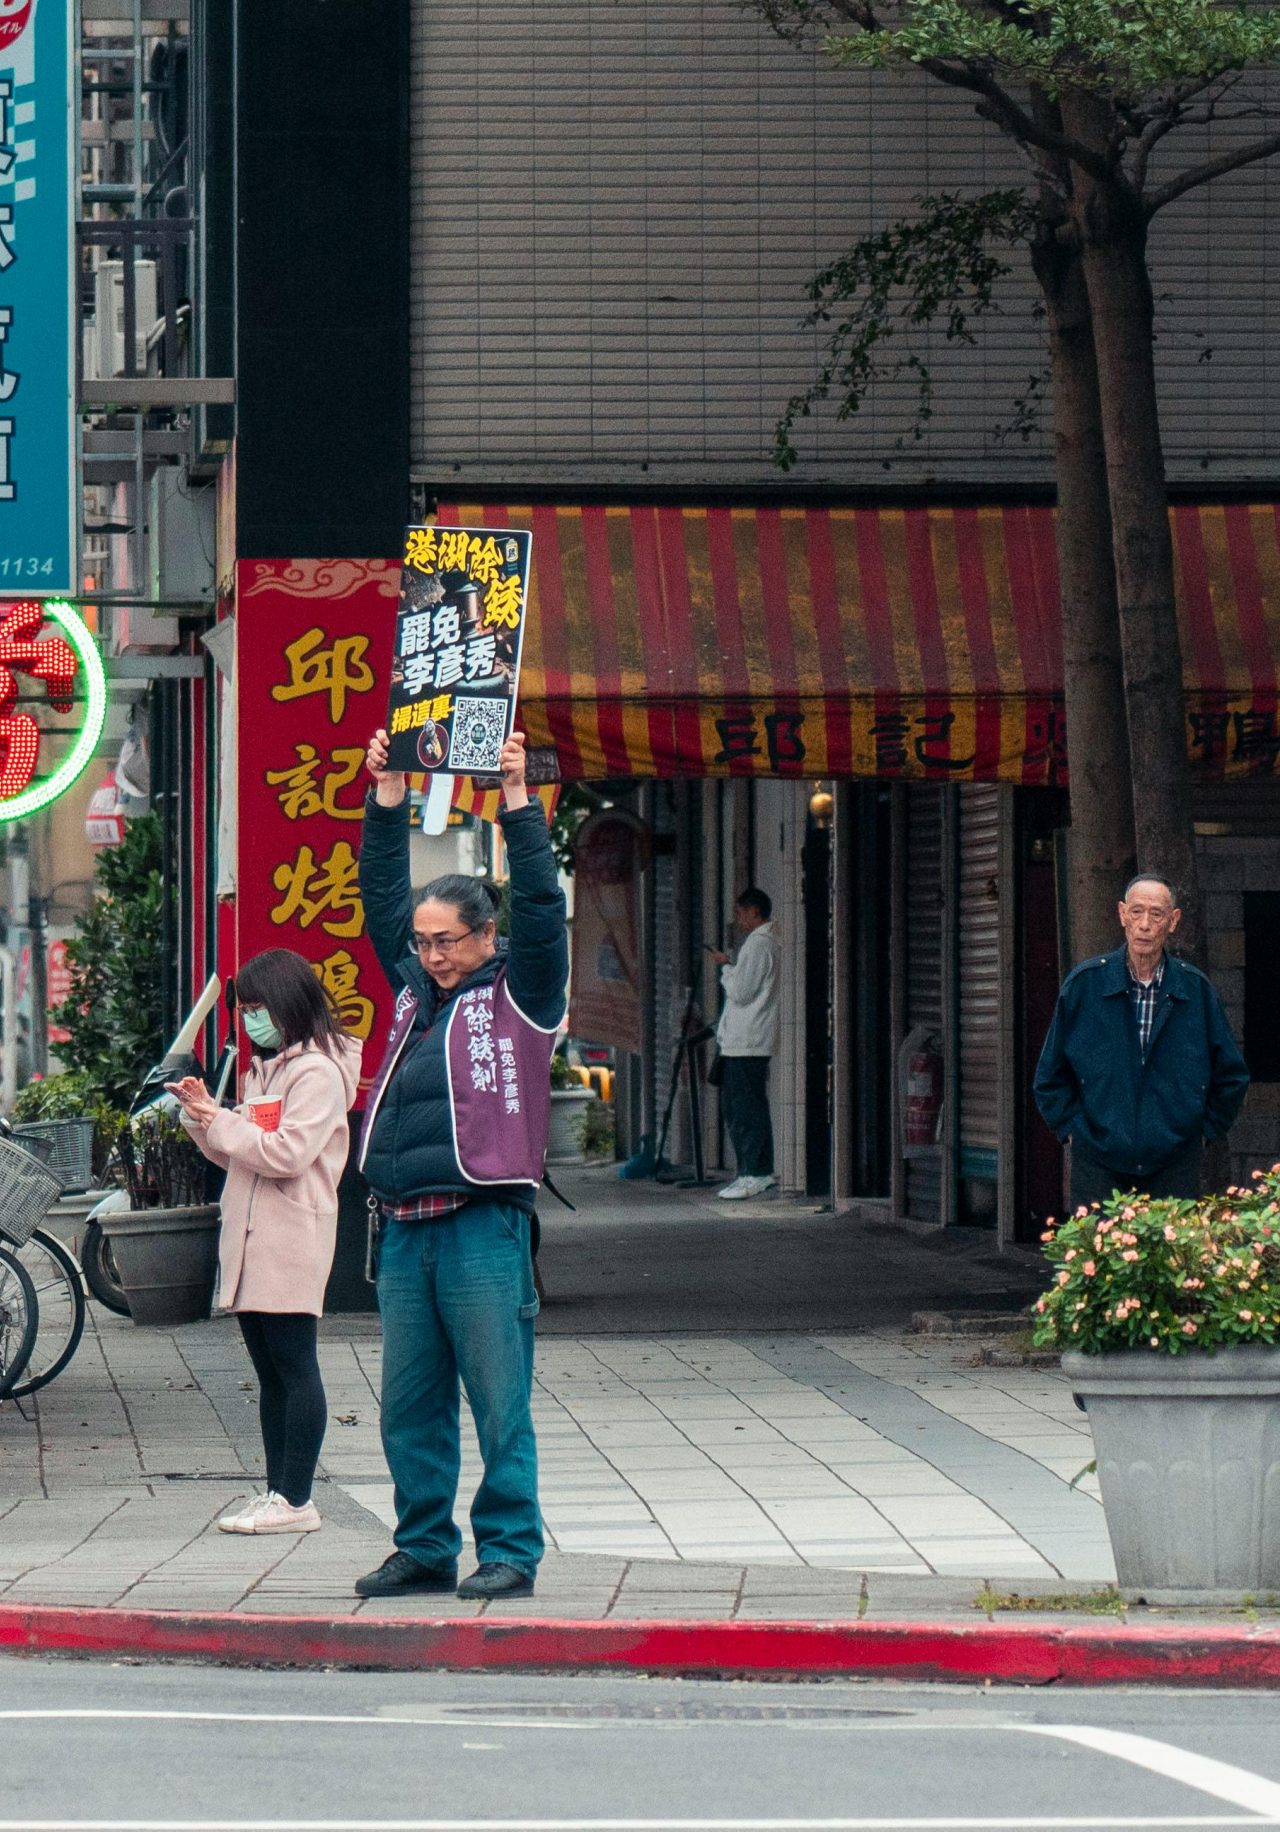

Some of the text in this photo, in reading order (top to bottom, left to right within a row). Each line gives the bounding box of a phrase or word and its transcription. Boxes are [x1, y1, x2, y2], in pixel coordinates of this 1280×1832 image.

[401, 605, 461, 659] 罷免
[403, 634, 497, 696] 李彥秀
[498, 1037, 521, 1115] 罷免李彥秀
